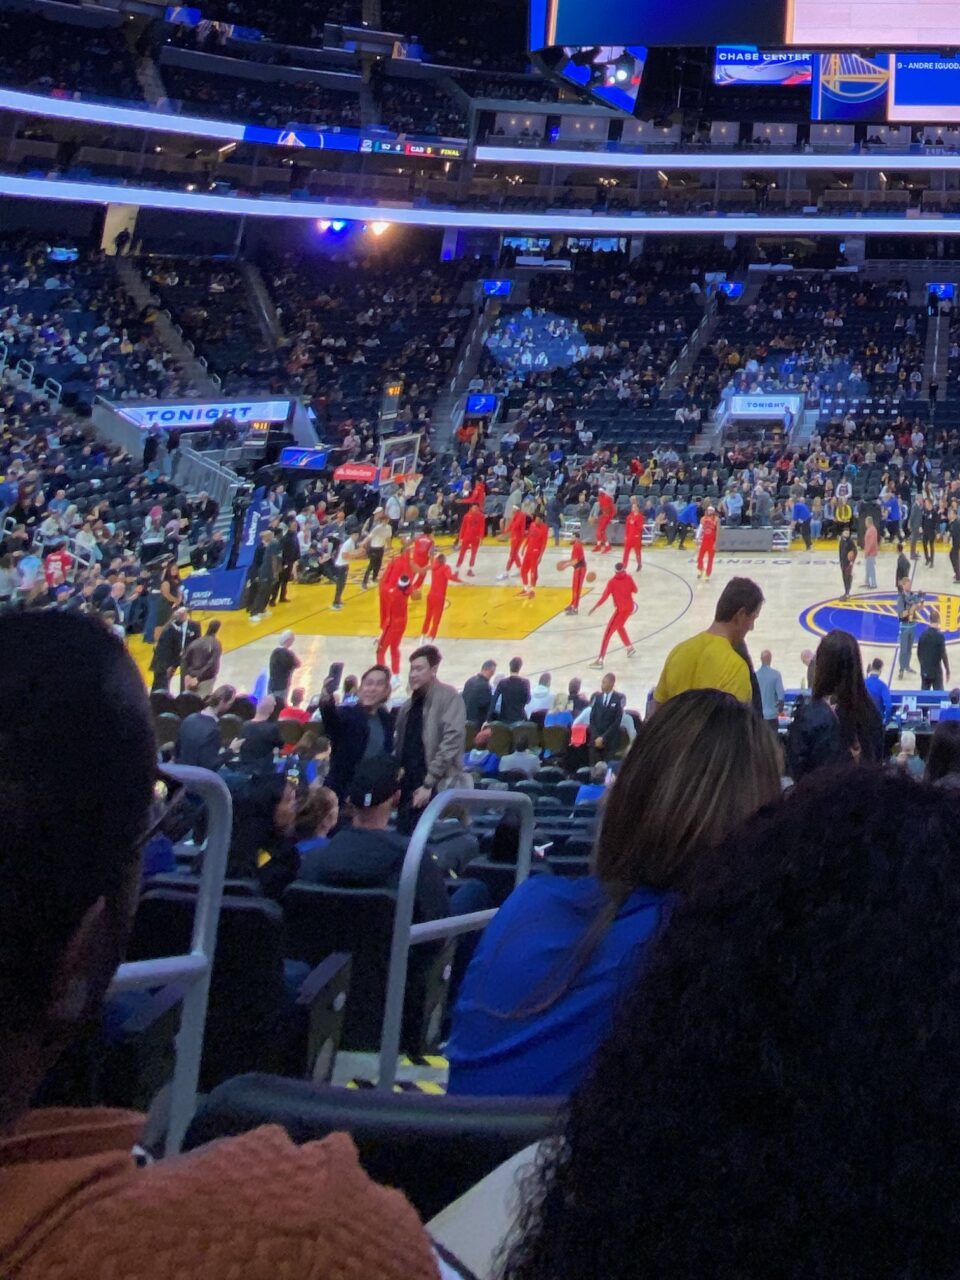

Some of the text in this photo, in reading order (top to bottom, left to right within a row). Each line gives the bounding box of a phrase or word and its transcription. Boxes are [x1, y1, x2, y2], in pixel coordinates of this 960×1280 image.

[719, 53, 759, 61] CHASE
[440, 148, 460, 156] FINAL
[145, 406, 252, 422] TONIGHT
